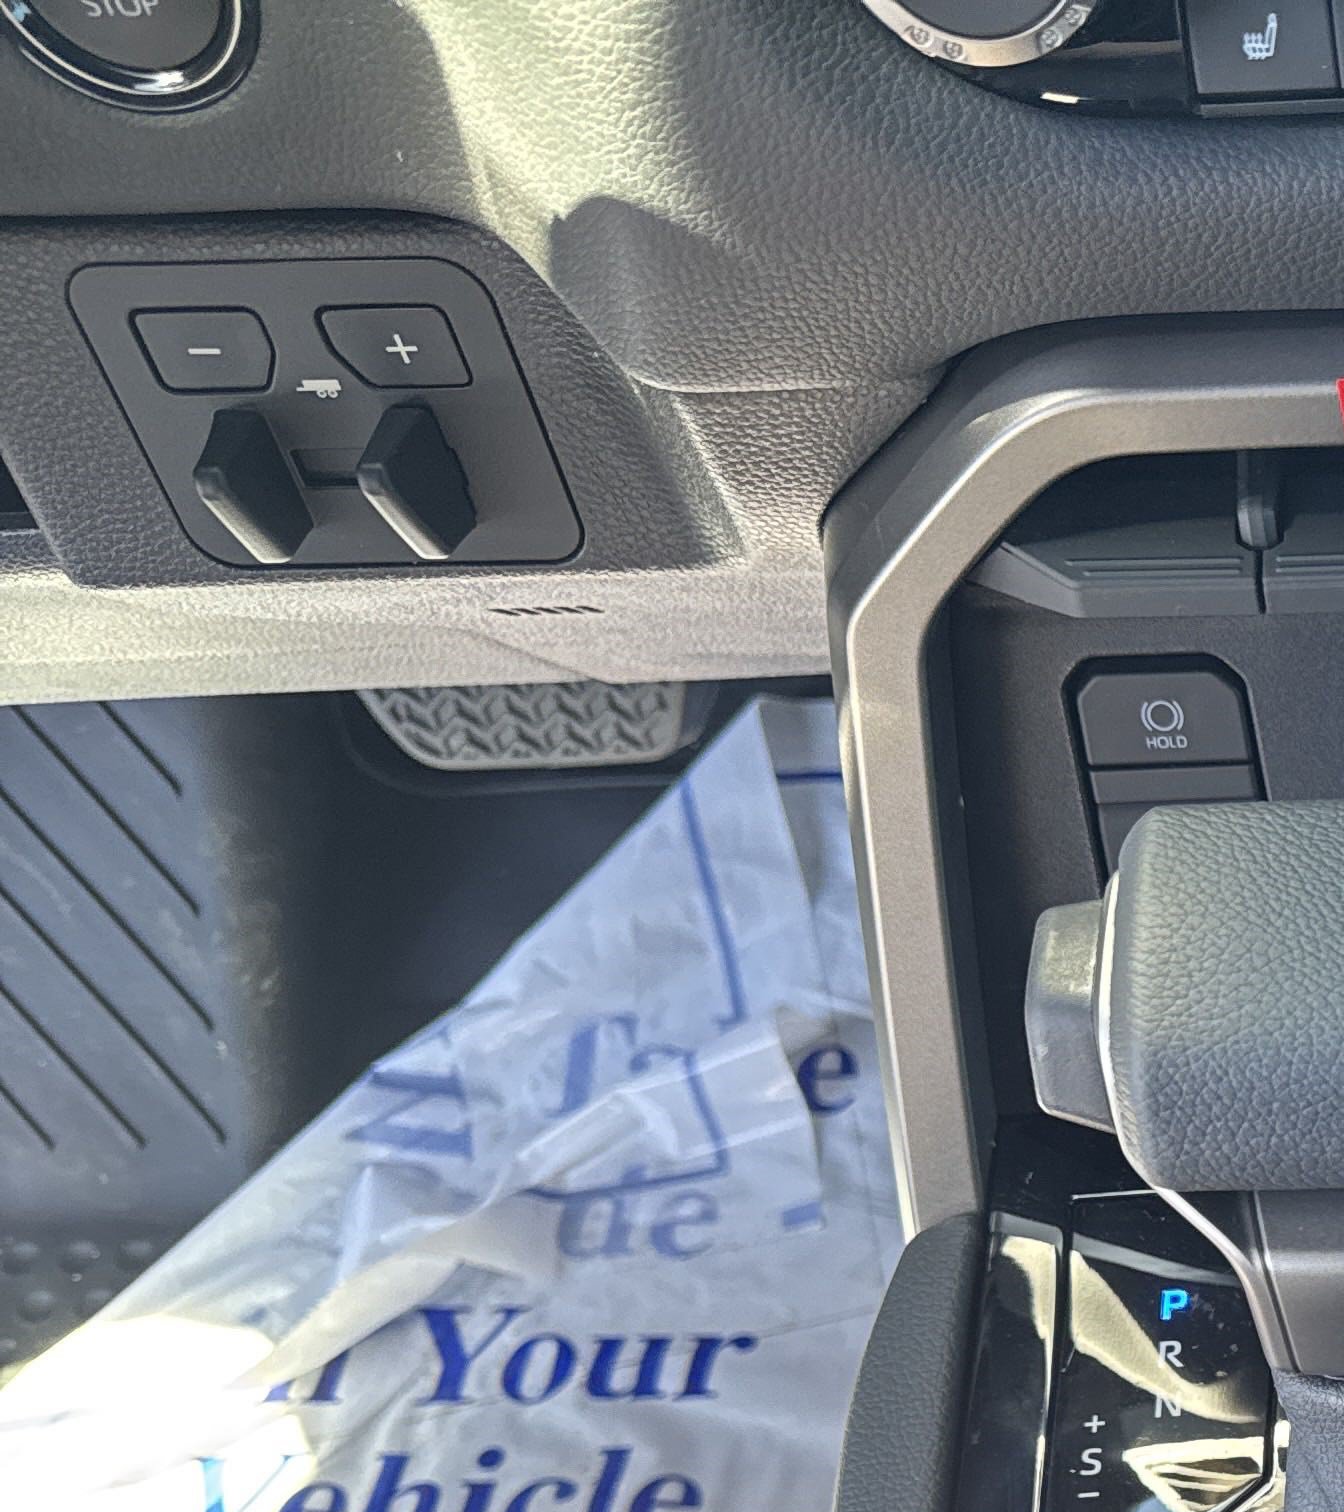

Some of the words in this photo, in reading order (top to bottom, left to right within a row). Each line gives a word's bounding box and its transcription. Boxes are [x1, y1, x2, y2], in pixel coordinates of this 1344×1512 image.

[1146, 735, 1188, 749] HOLD
[1159, 1289, 1188, 1319] P
[412, 1306, 759, 1406] Your
[1158, 1341, 1183, 1367] R
[1079, 1448, 1102, 1475] S
